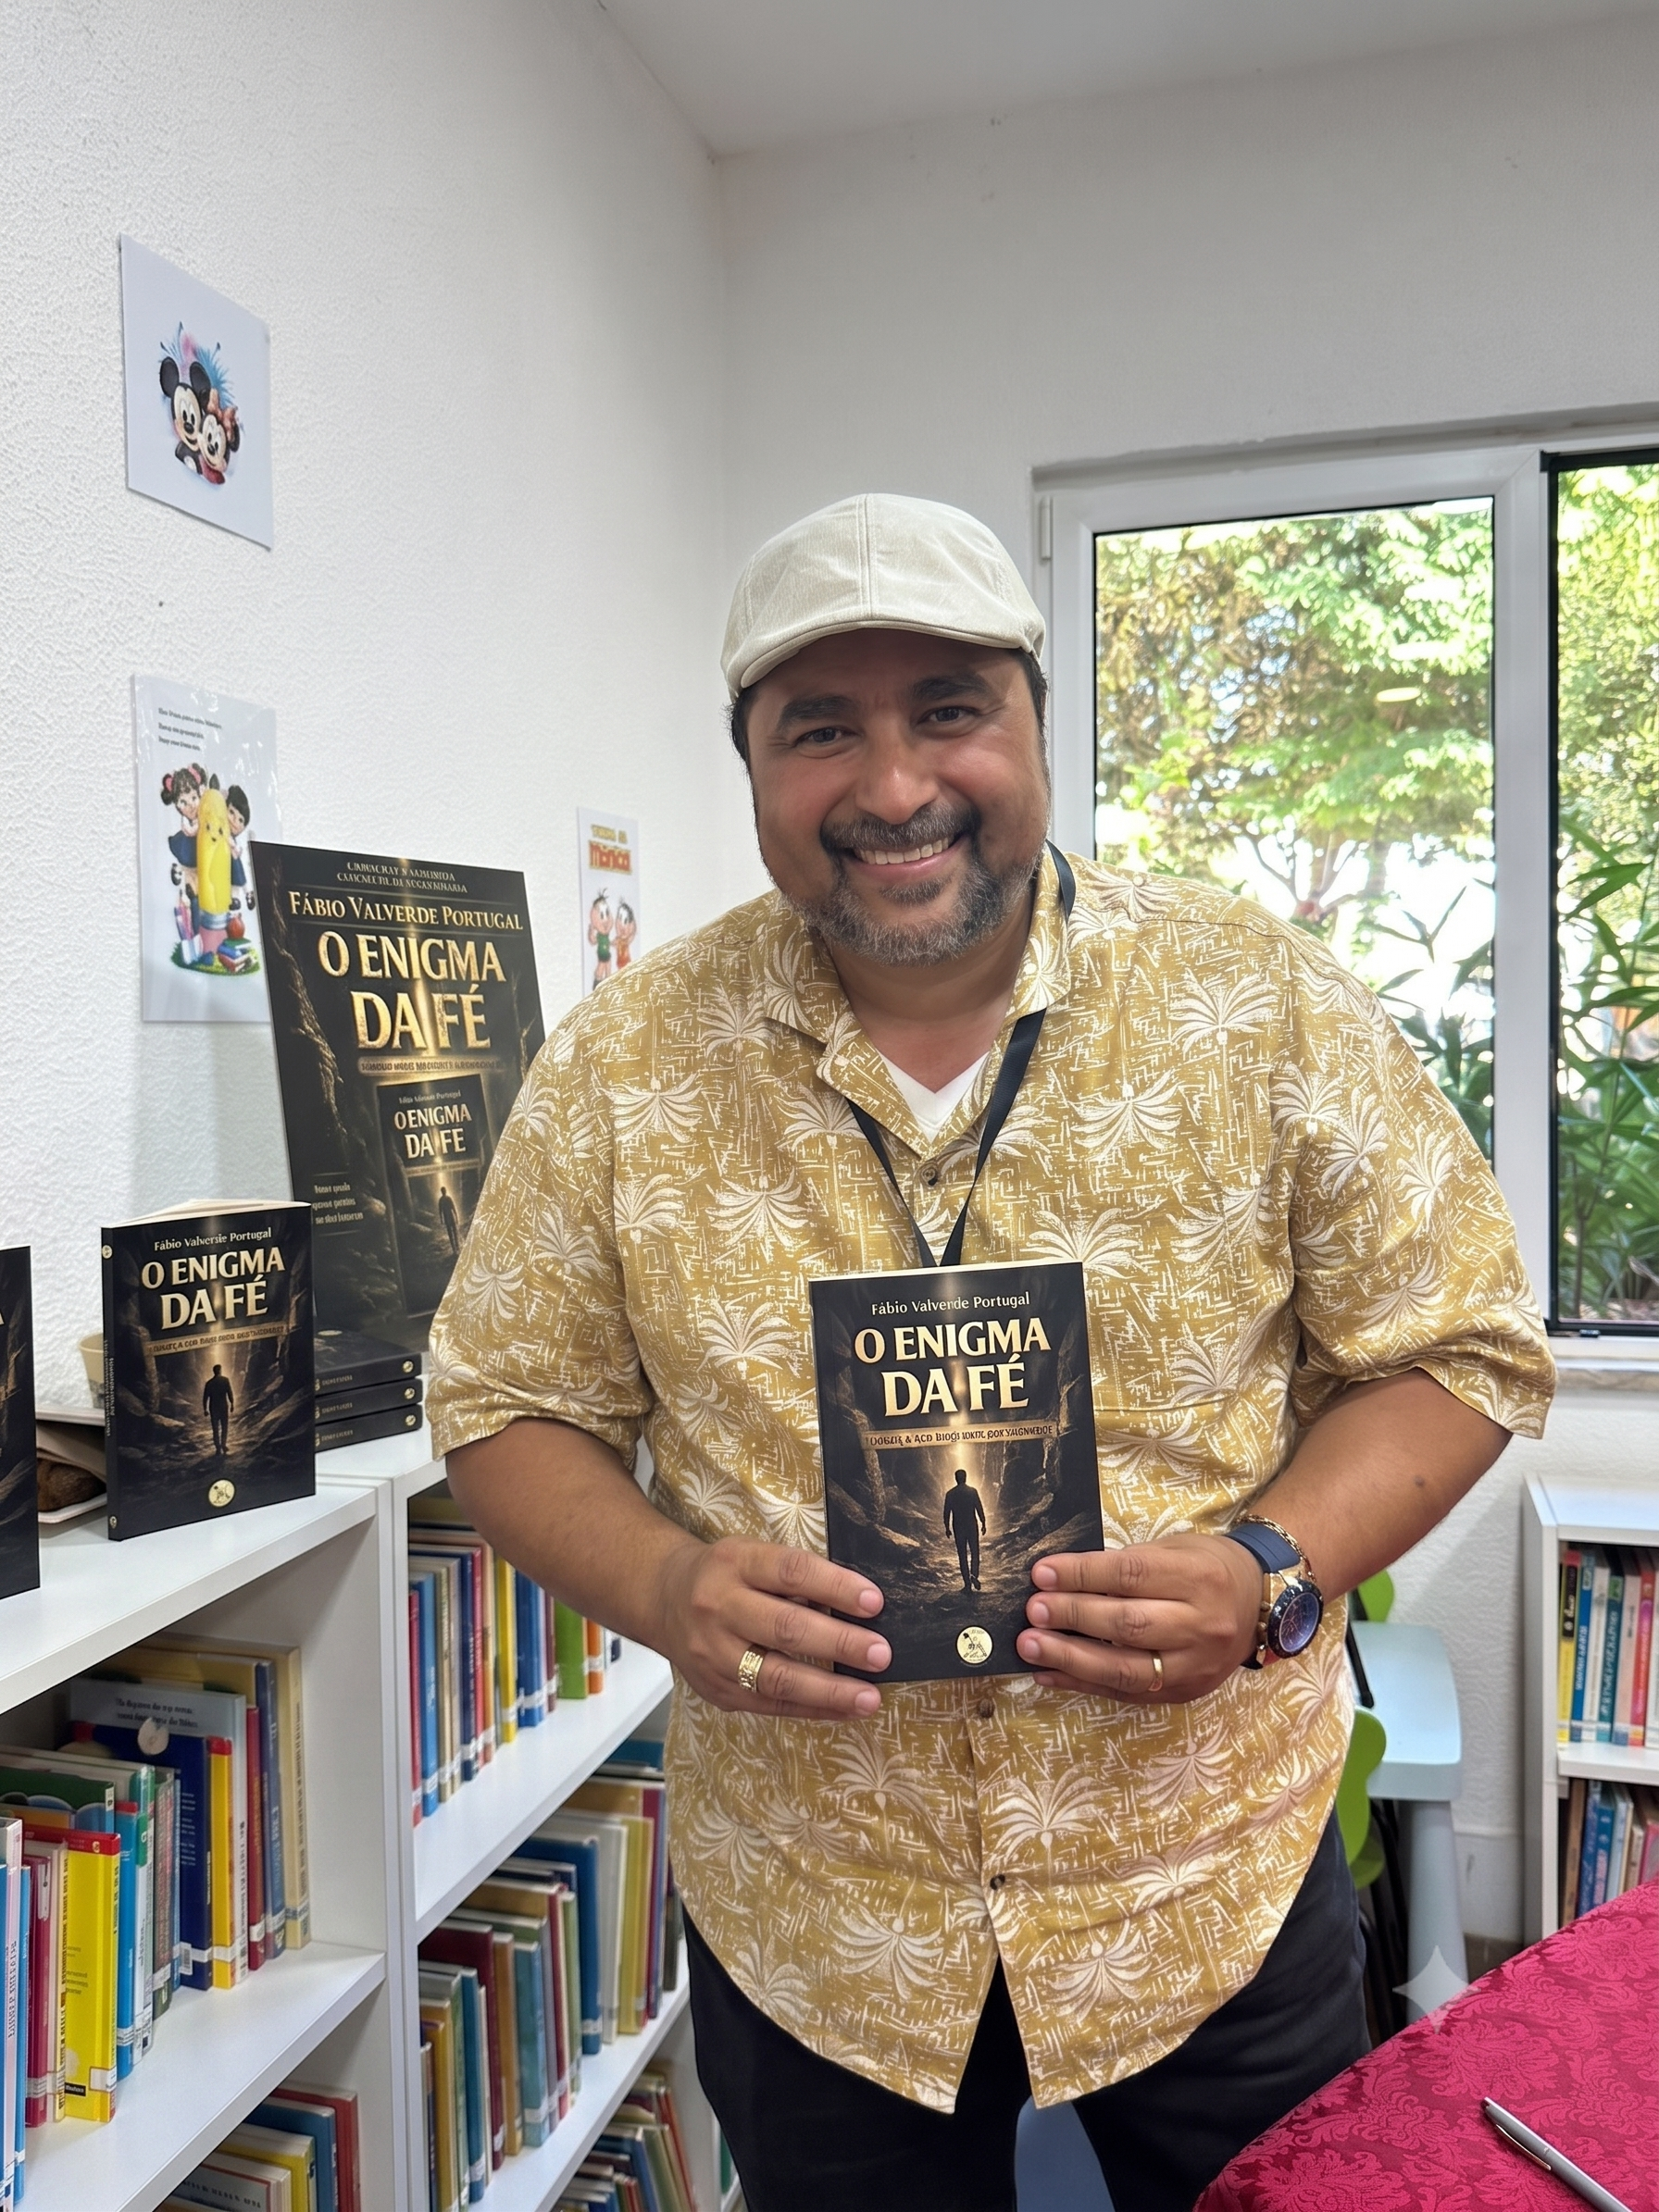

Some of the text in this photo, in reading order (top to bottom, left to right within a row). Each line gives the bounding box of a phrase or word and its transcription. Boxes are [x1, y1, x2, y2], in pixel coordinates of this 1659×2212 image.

[288, 890, 524, 930] FÁBIO VALVERDE PORTUGAL
[318, 931, 507, 983] O ENIGMA
[350, 984, 492, 1050] DA FÉ
[405, 1132, 435, 1159] DA
[230, 1226, 272, 1241] Portugal
[141, 1246, 286, 1290] O ENIGMA
[160, 1274, 269, 1330] DA FÉ
[973, 1291, 1030, 1309] Portugal
[854, 1316, 1052, 1364] O ENIGMA
[880, 1353, 1029, 1418] DA FÉ
